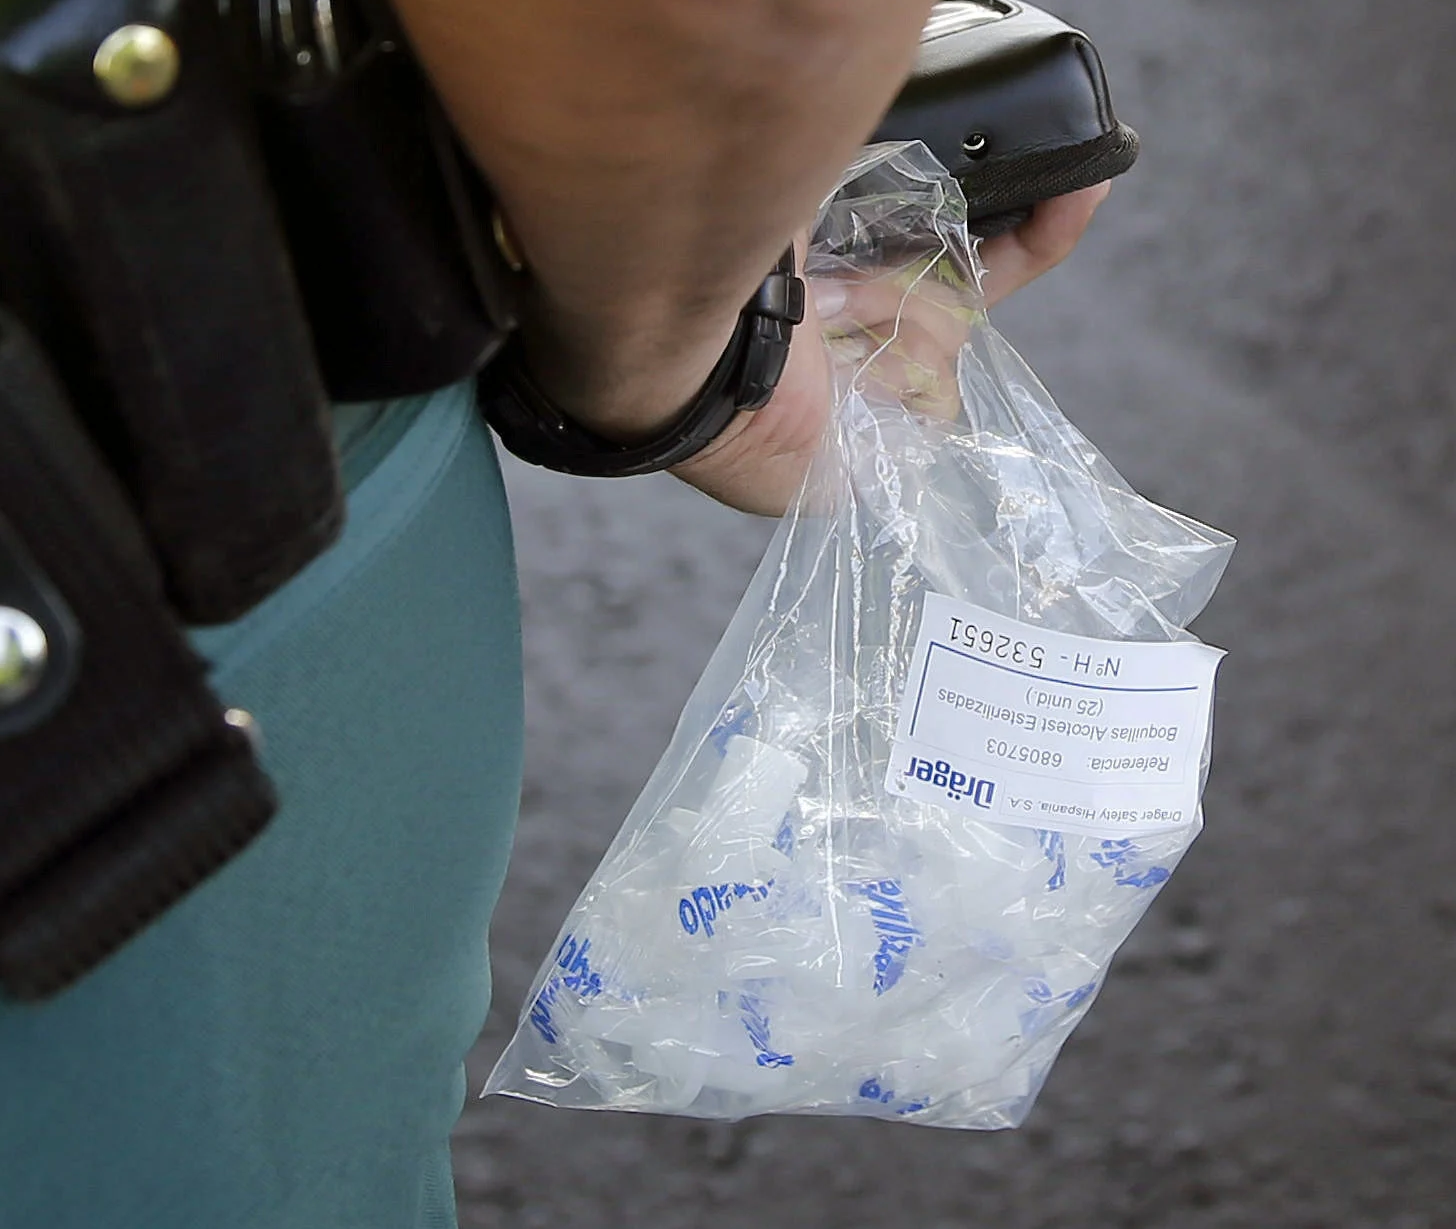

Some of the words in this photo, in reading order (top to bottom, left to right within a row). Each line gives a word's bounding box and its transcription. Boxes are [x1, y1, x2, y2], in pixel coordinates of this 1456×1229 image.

[948, 617, 1046, 669] 532651
[1074, 653, 1091, 673] H
[938, 689, 1037, 729] Esterilizadas
[1025, 688, 1073, 711] unid.)
[1077, 698, 1104, 716] (25
[1040, 718, 1107, 738] Alcotest
[1111, 724, 1178, 742] Boquillas
[986, 738, 1063, 767] 6805703
[1087, 756, 1169, 772] Referencia:
[903, 757, 996, 809] Dräger
[1100, 808, 1138, 822] Safety
